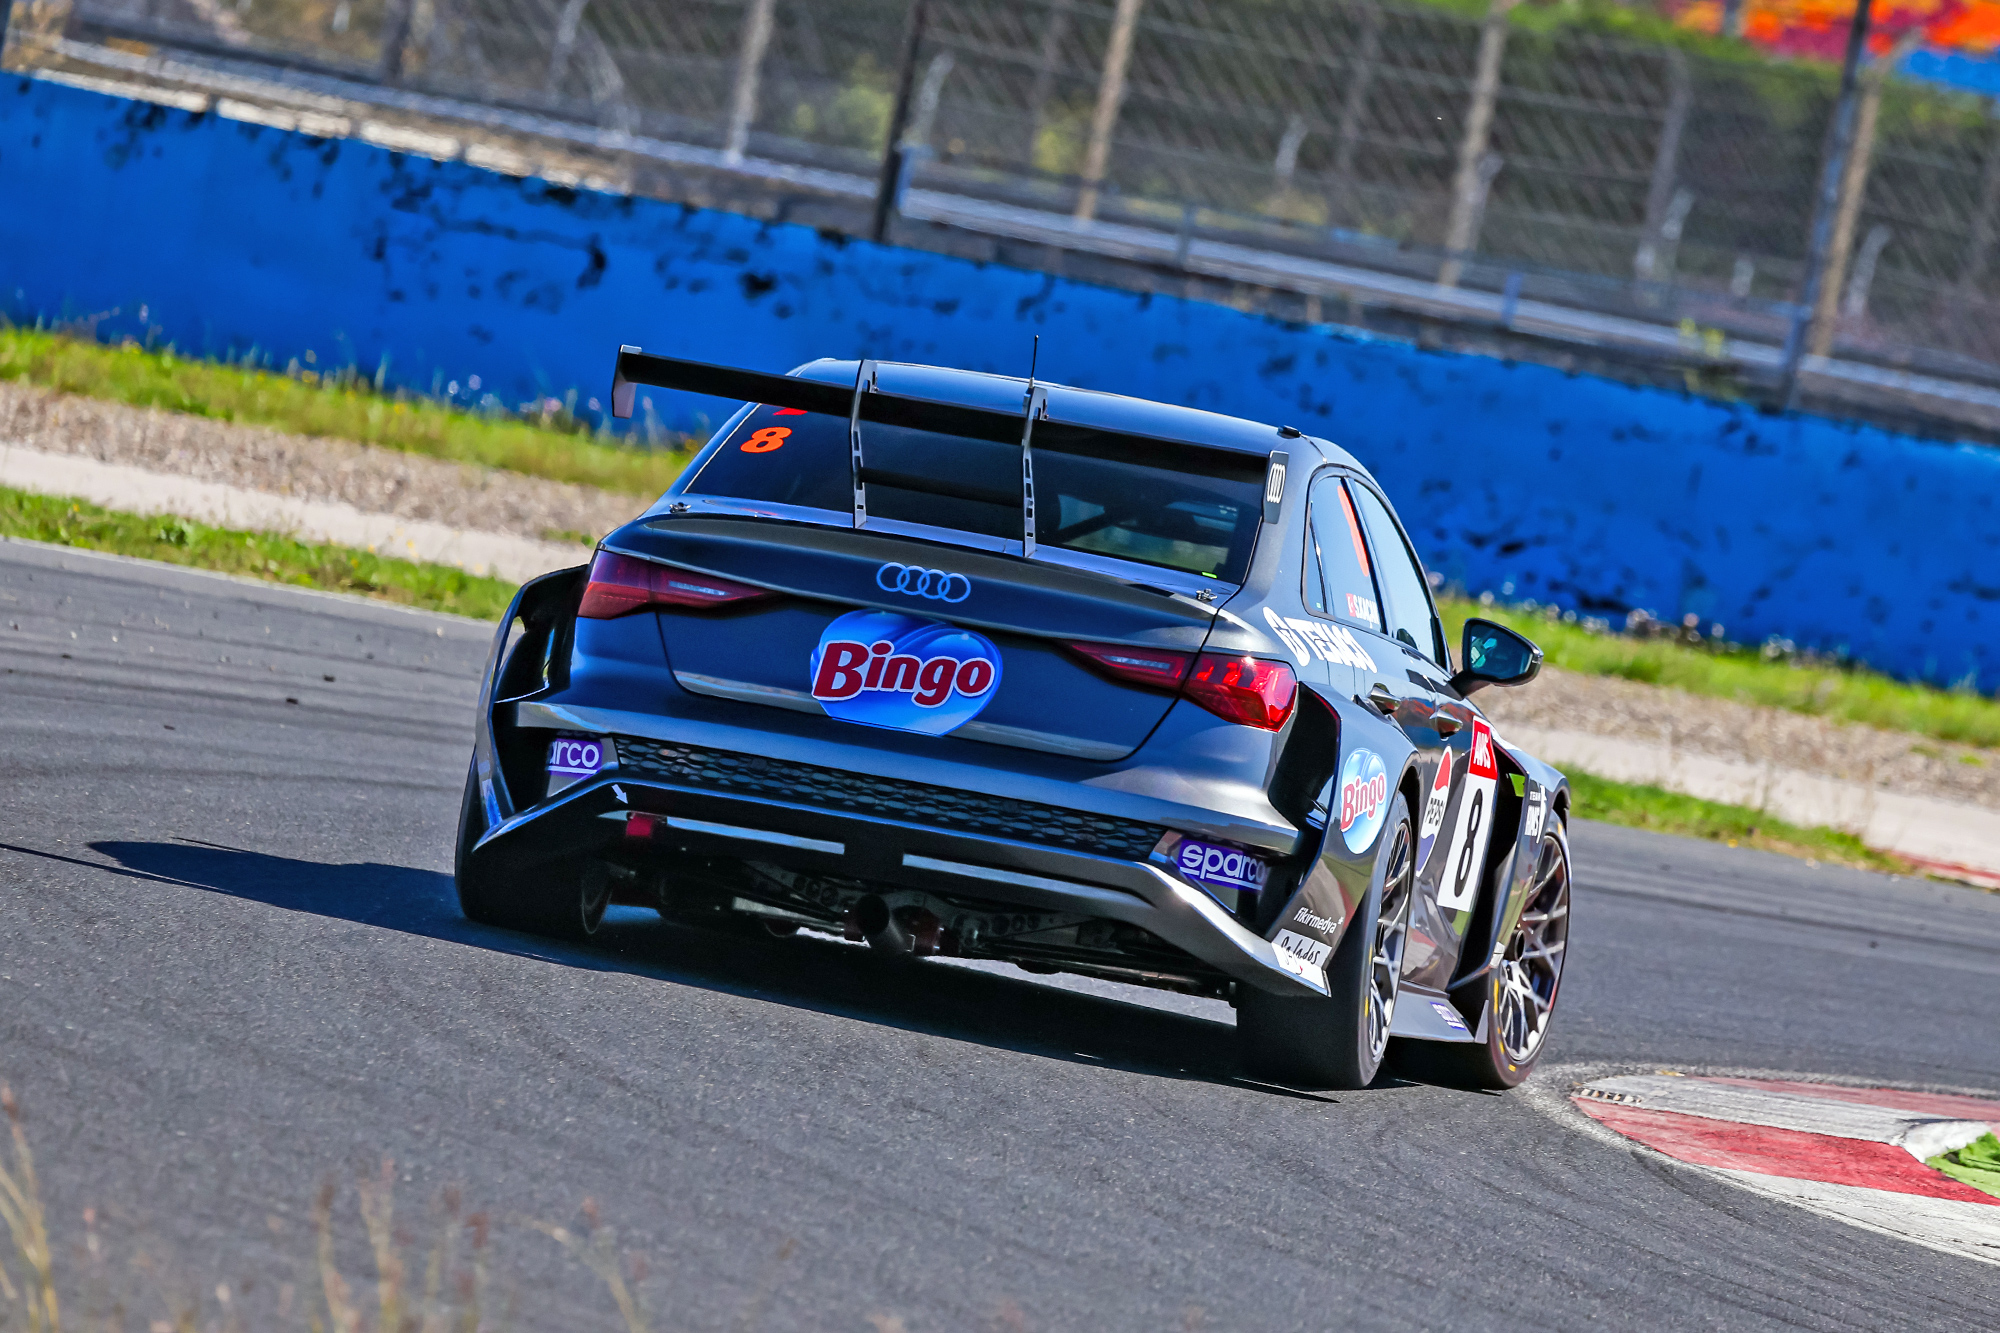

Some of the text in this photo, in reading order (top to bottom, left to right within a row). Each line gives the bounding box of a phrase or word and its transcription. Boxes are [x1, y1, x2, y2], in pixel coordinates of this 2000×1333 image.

[740, 426, 792, 453] 8
[1283, 616, 1378, 674] TEXACO
[812, 640, 995, 708] Bingo
[1339, 775, 1387, 833] Bingo
[1425, 797, 1445, 827] PEPSI
[1181, 844, 1266, 883] sparco
[1454, 788, 1483, 898] 8
[1293, 906, 1337, 935] fikirmedya
